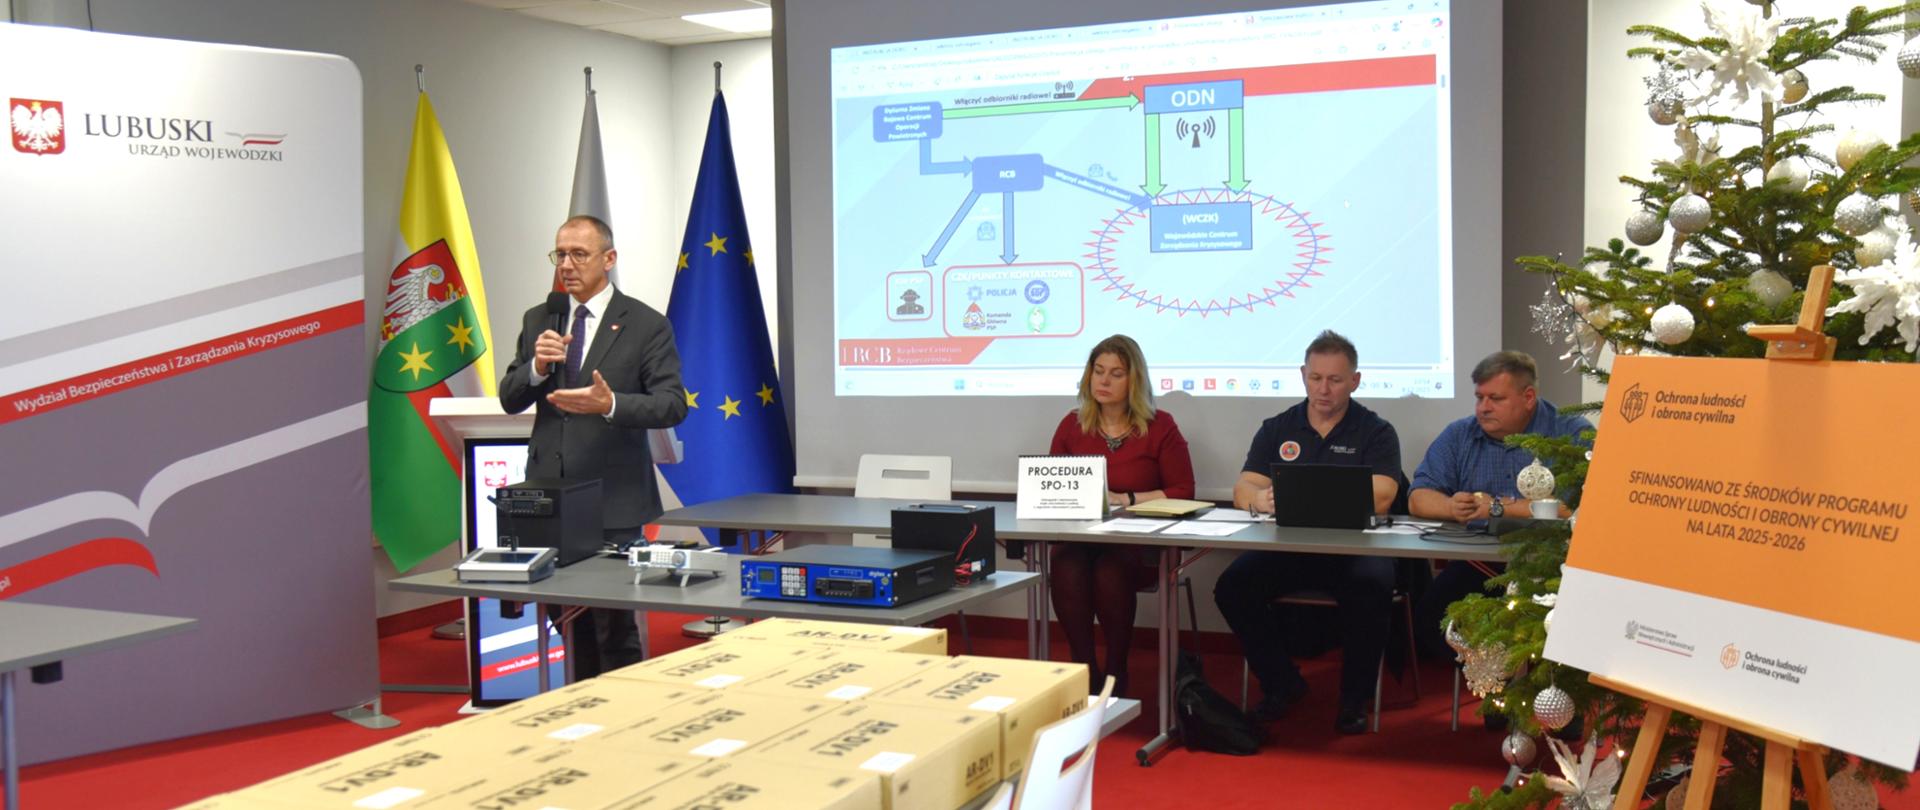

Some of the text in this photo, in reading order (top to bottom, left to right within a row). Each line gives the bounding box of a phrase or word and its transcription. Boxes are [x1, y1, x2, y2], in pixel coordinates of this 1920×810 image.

[1171, 88, 1215, 108] ODN
[84, 113, 214, 143] LUBUSKI
[128, 143, 181, 159] URZĄD
[1182, 212, 1219, 225] (WCZK)
[986, 288, 1017, 297] POLICJA
[14, 388, 67, 412] Wydział
[69, 363, 168, 399] Bezpieczeństwa
[176, 340, 246, 370] Zarządzania
[247, 320, 321, 349] Kryzysowego
[1655, 390, 1747, 408] Ochrona ludności
[1656, 407, 1692, 420] obrona
[1693, 410, 1736, 424] cywilna
[1028, 466, 1093, 476] PROCEDURA
[1041, 480, 1079, 490] SPO-13
[1628, 470, 1908, 519] SFINANSOWANO ZE ŚRODKÓW PROGRAMU
[1628, 490, 1687, 510] OCHRONY
[1686, 498, 1750, 520] LUDNOŚCI
[1759, 508, 1820, 530] OBRONY
[1821, 517, 1900, 543] CYWILNEJ
[1686, 519, 1807, 551] NA LATA 2025-2026
[793, 630, 893, 641] AR-DV1
[665, 653, 742, 677] AR-DV1
[791, 661, 865, 689] AR-DV1
[1745, 651, 1808, 675] Ochrona ludności
[1746, 663, 1771, 676] obrona
[1771, 670, 1801, 684] cywilna
[933, 672, 1002, 700] AR-DV1
[517, 697, 610, 728] AR-DV1
[656, 709, 746, 743] AR-DV1
[817, 721, 899, 757] AR-DV1
[323, 752, 442, 792] AR-DV1
[966, 752, 994, 779] AR-DV1
[475, 769, 590, 810] AR-DV1
[690, 784, 760, 810] AR-D
